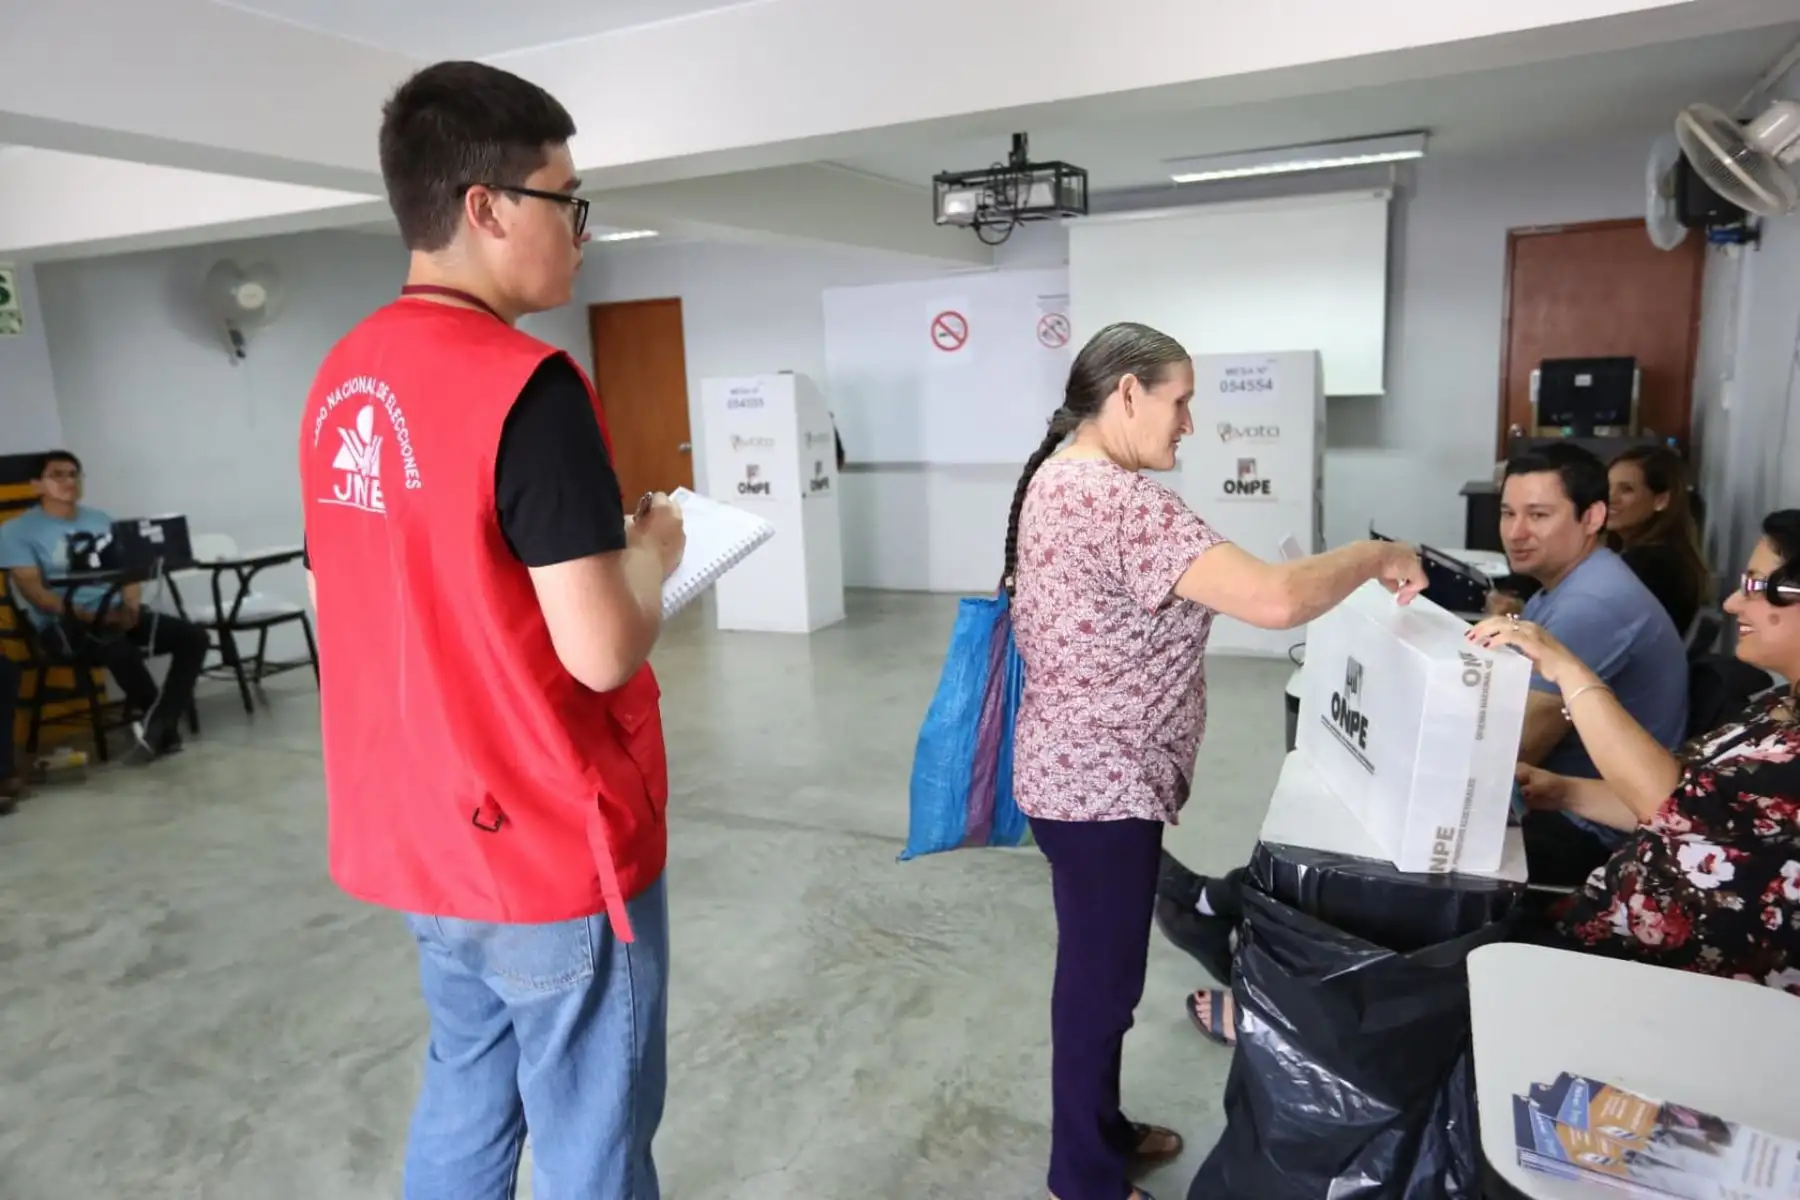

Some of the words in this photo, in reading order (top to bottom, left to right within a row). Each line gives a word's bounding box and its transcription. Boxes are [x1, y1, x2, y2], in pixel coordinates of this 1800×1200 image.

[326, 374, 377, 411] NACIONAL
[375, 381, 390, 402] DE
[385, 392, 422, 490] ELECCIONES
[333, 471, 386, 509] JNE
[737, 480, 770, 495] ONPE
[1223, 479, 1271, 495] ONPE
[1331, 691, 1369, 750] ONPE
